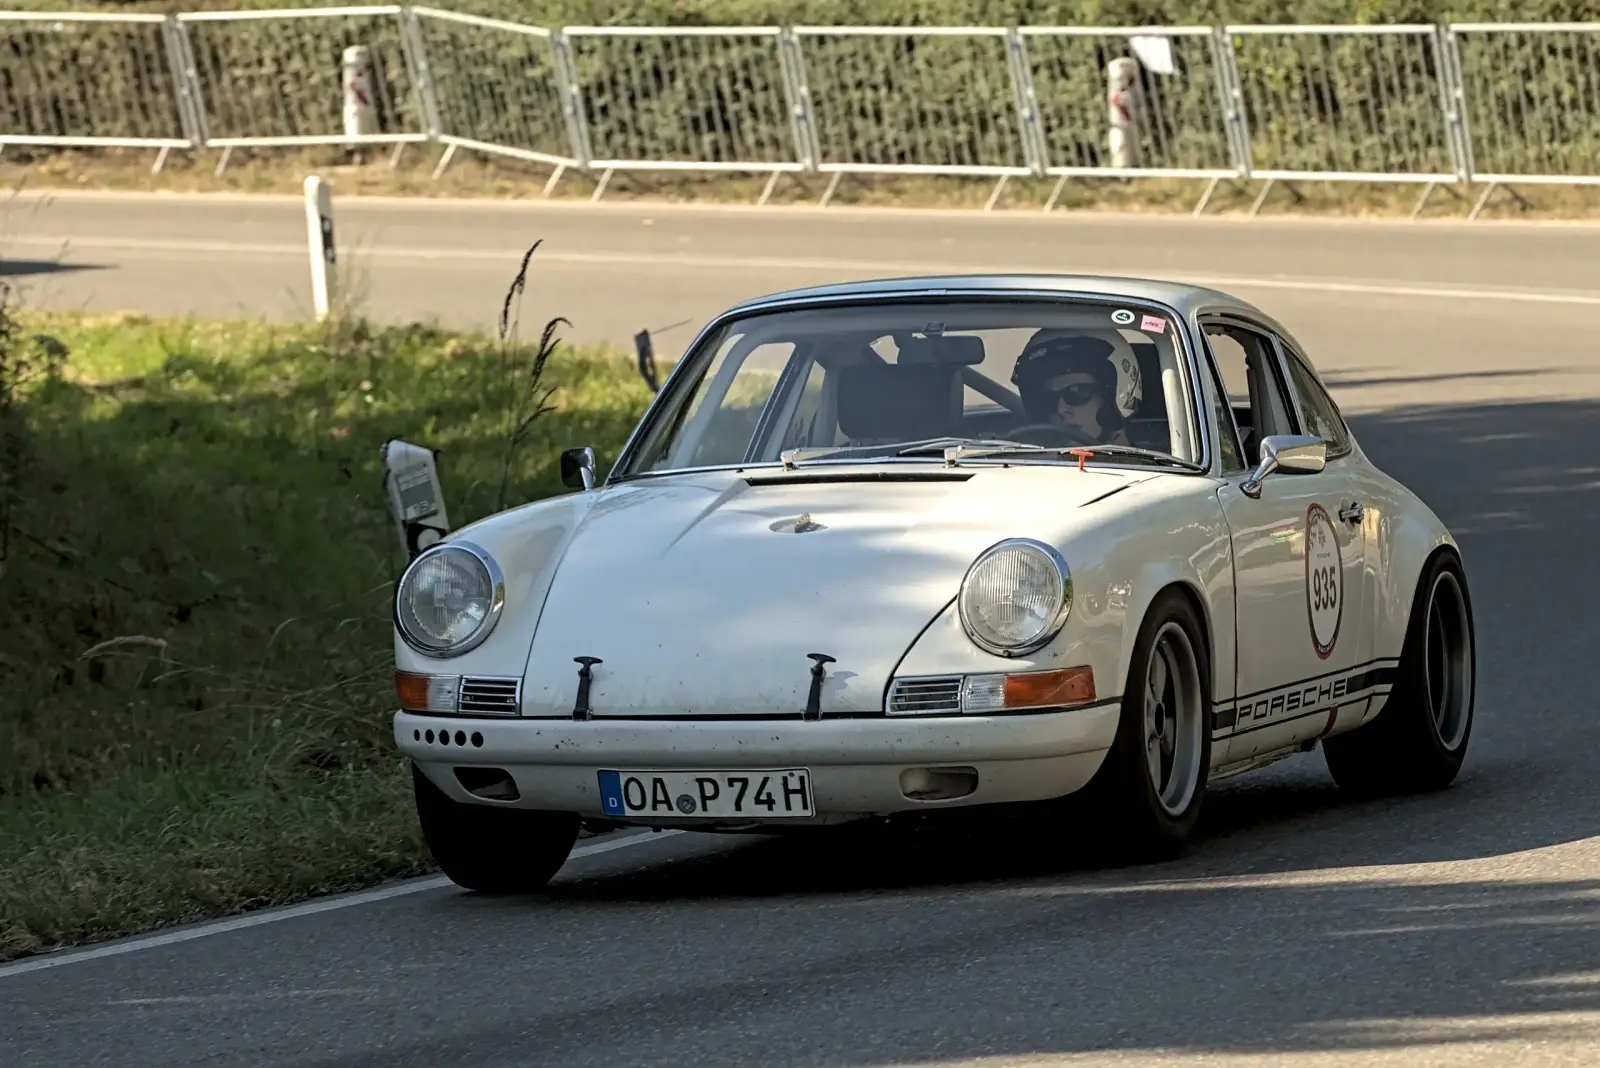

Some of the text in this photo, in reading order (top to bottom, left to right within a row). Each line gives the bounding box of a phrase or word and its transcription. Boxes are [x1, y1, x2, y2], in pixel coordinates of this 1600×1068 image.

[1313, 566, 1337, 612] 935
[1237, 678, 1347, 725] PORSCHE
[608, 797, 618, 808] D
[623, 776, 674, 812] OA
